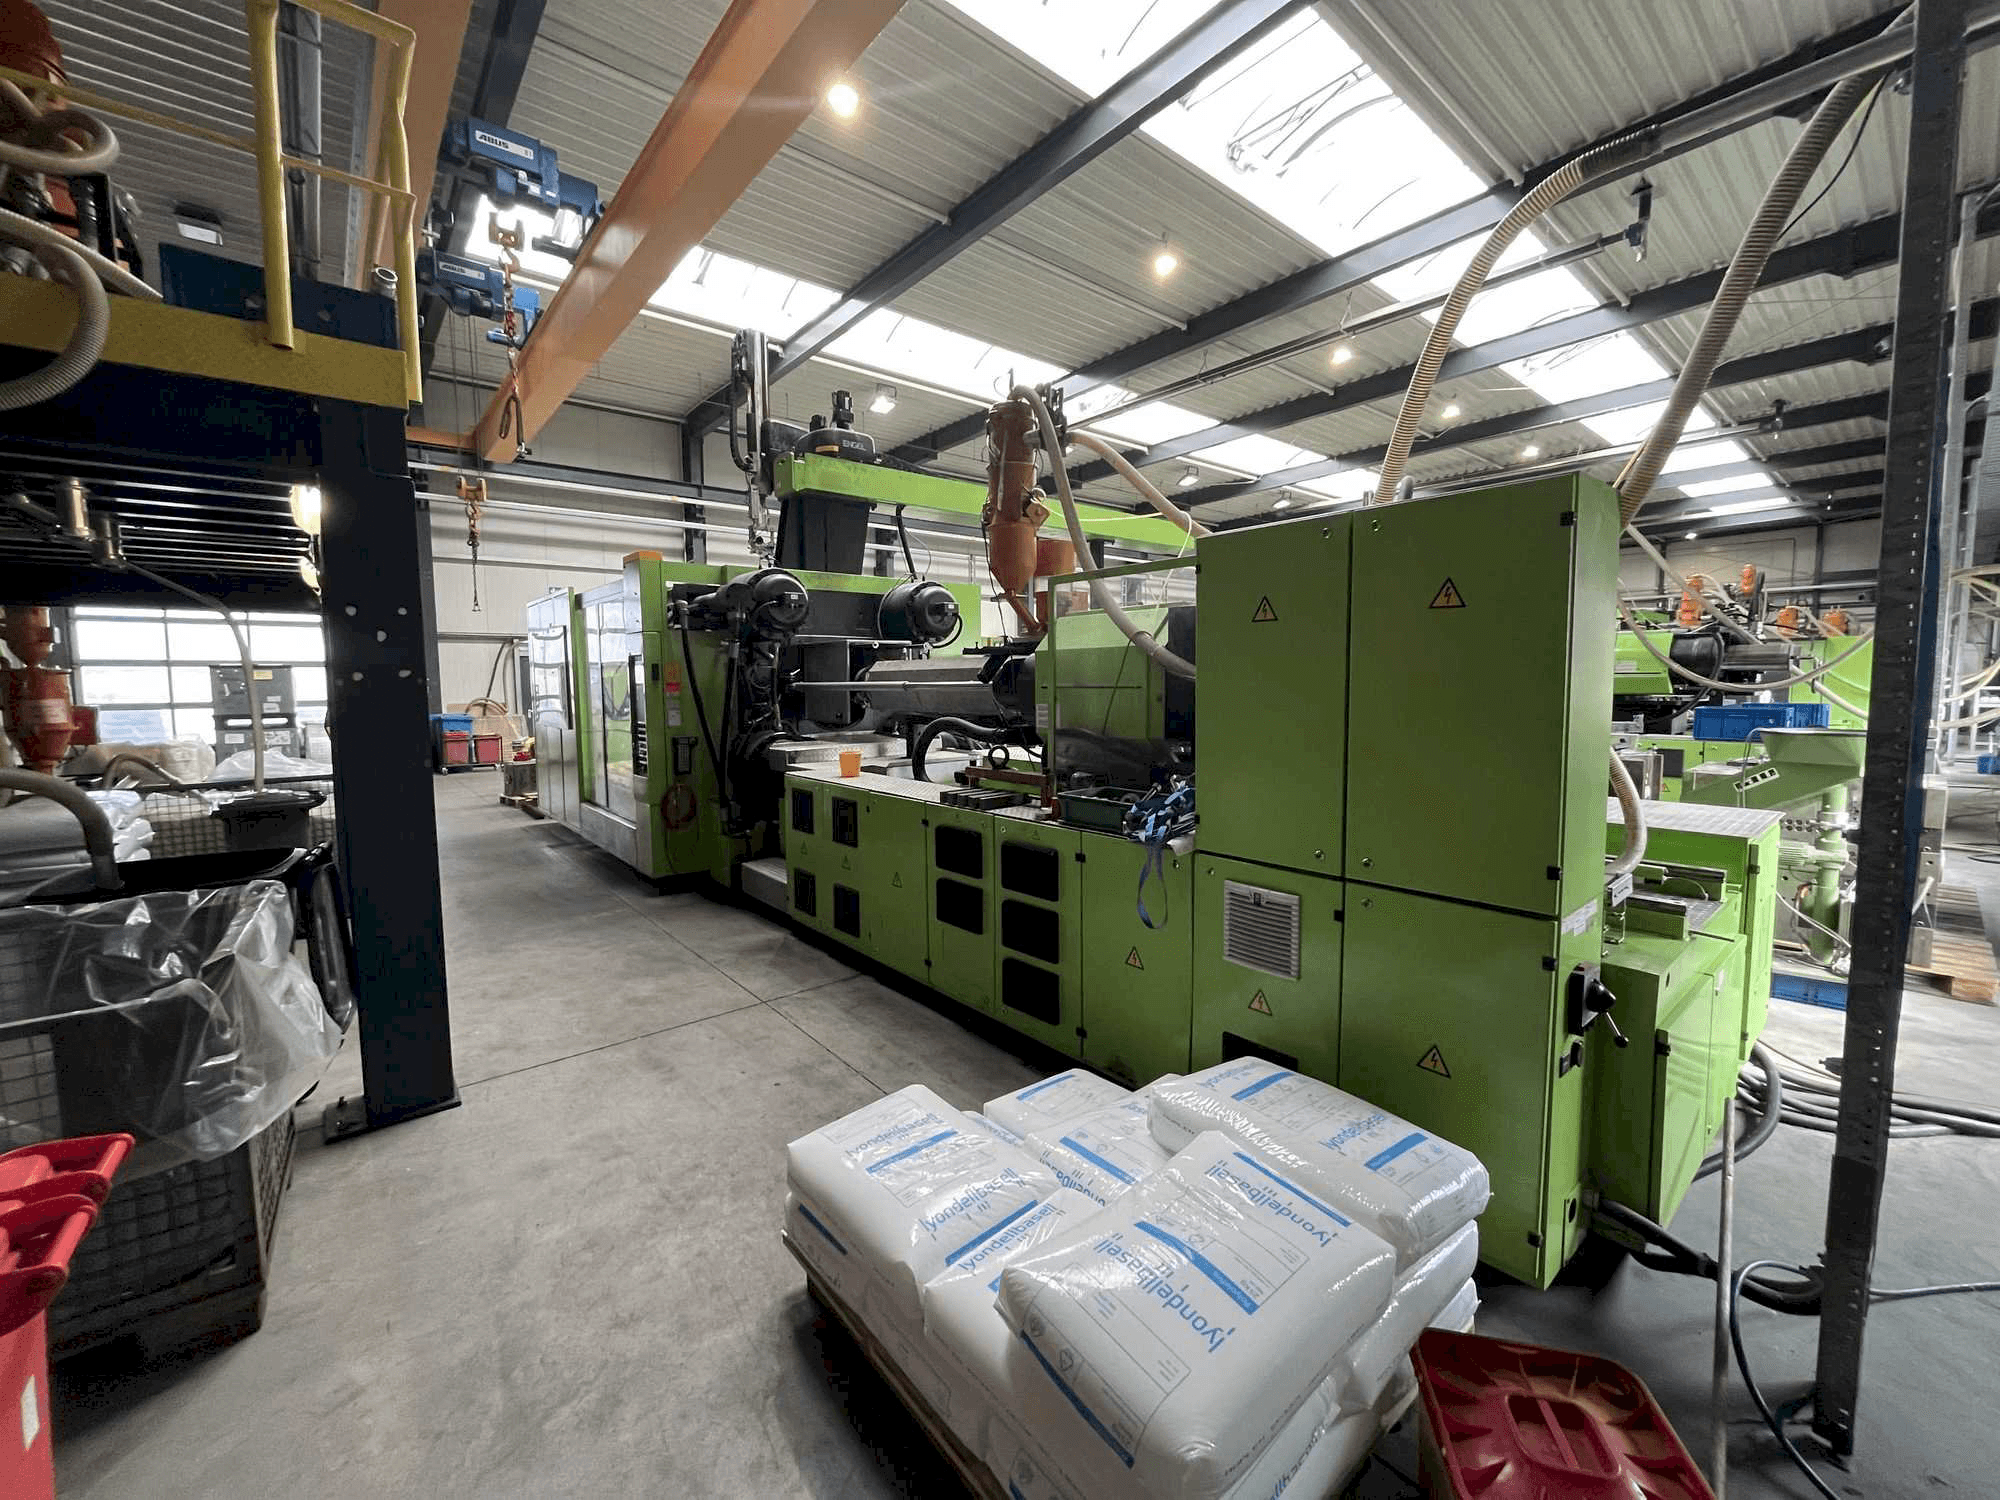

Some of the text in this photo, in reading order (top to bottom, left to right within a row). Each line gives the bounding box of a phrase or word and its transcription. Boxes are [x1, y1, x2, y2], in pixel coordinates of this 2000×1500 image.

[918, 1167, 1021, 1233] lyondellbasell
[958, 1202, 1058, 1271] lyondellbasell
[1204, 1163, 1331, 1248] lyondellbasell
[1093, 1239, 1225, 1353] lyondellbasell
